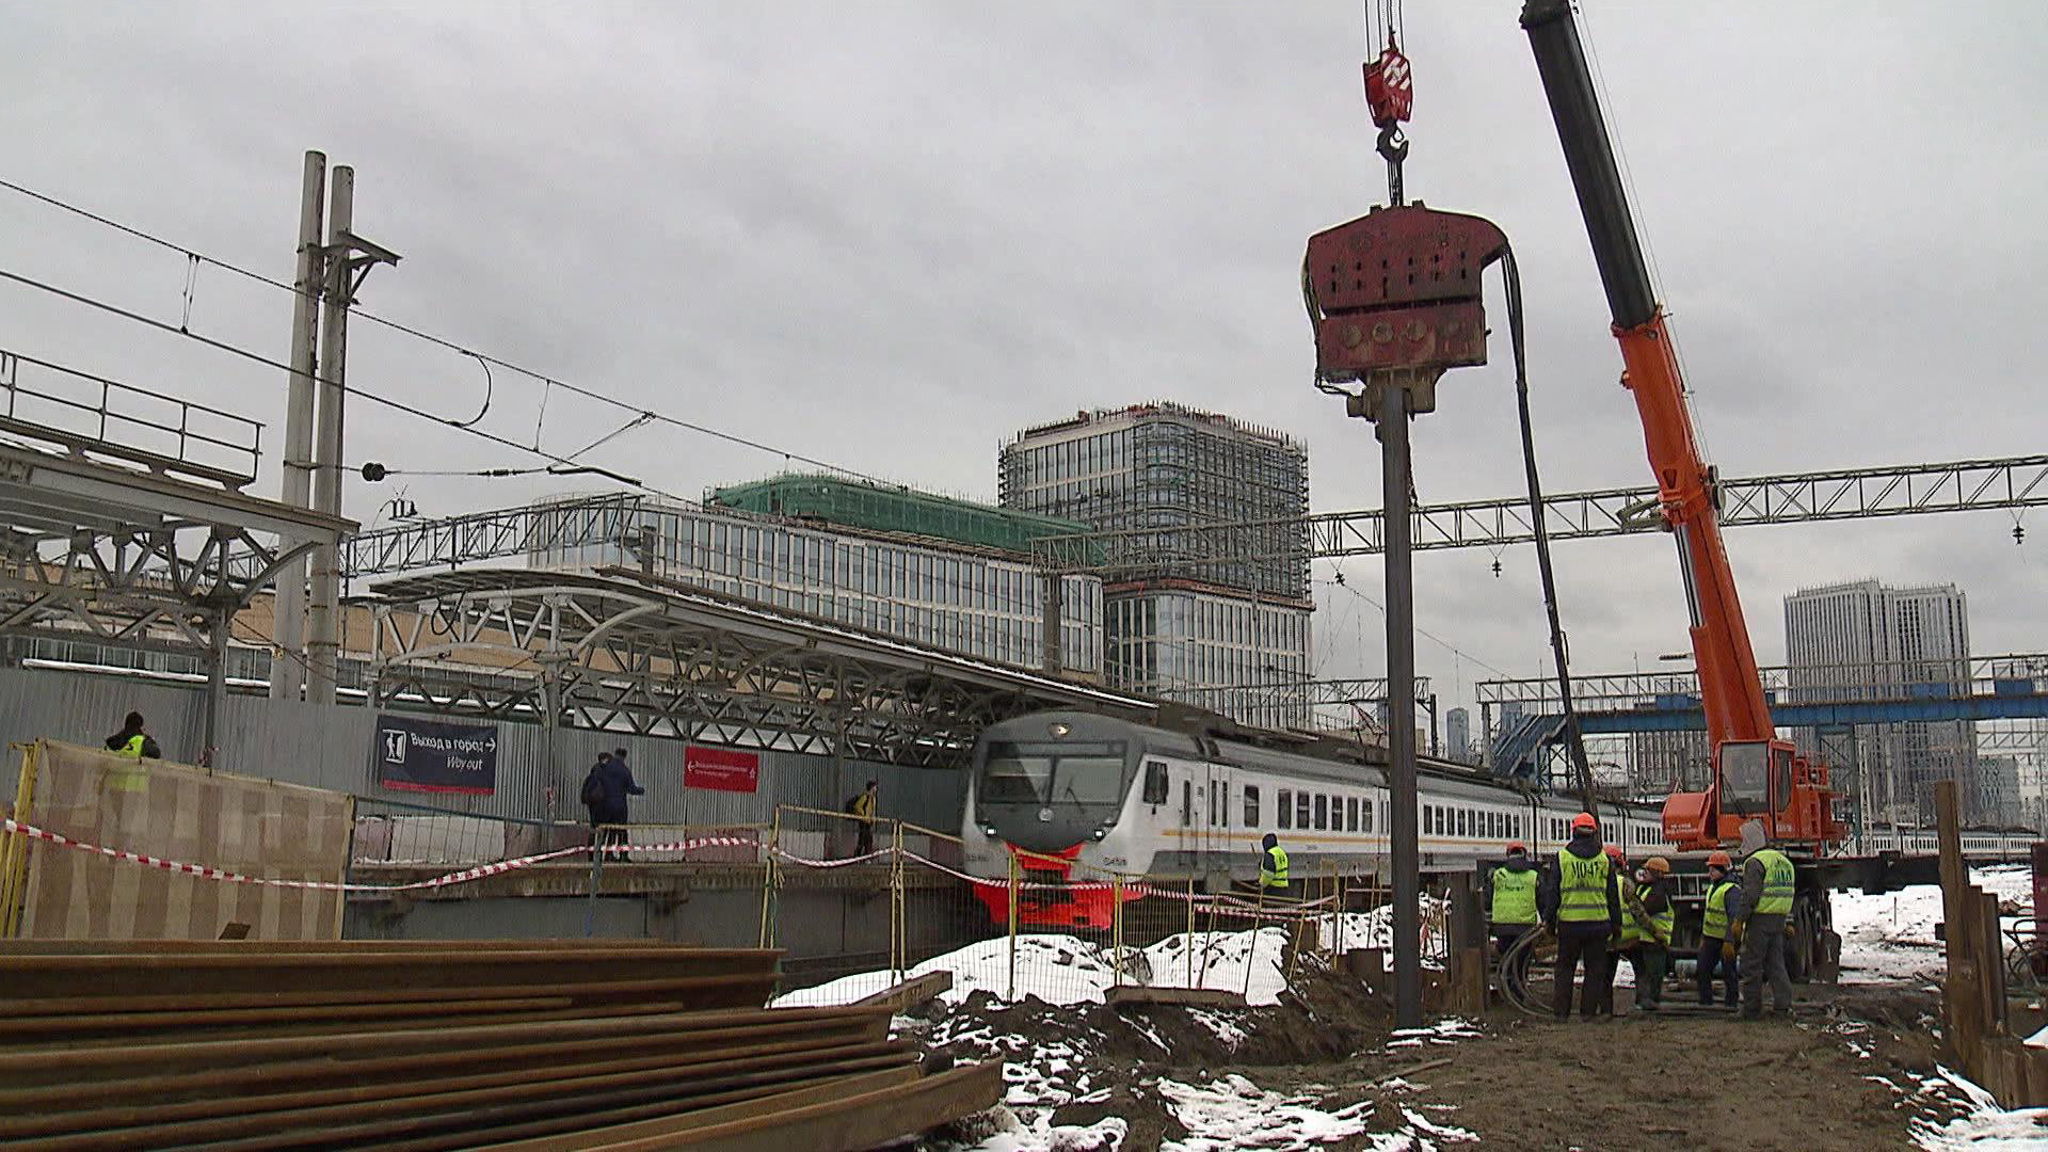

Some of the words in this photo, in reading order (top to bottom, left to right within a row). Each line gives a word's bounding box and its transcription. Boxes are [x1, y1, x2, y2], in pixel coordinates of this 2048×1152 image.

[410, 732, 444, 751] Выход
[445, 739, 453, 750] в
[453, 739, 484, 754] город
[446, 755, 466, 771] Way
[466, 758, 483, 771] out
